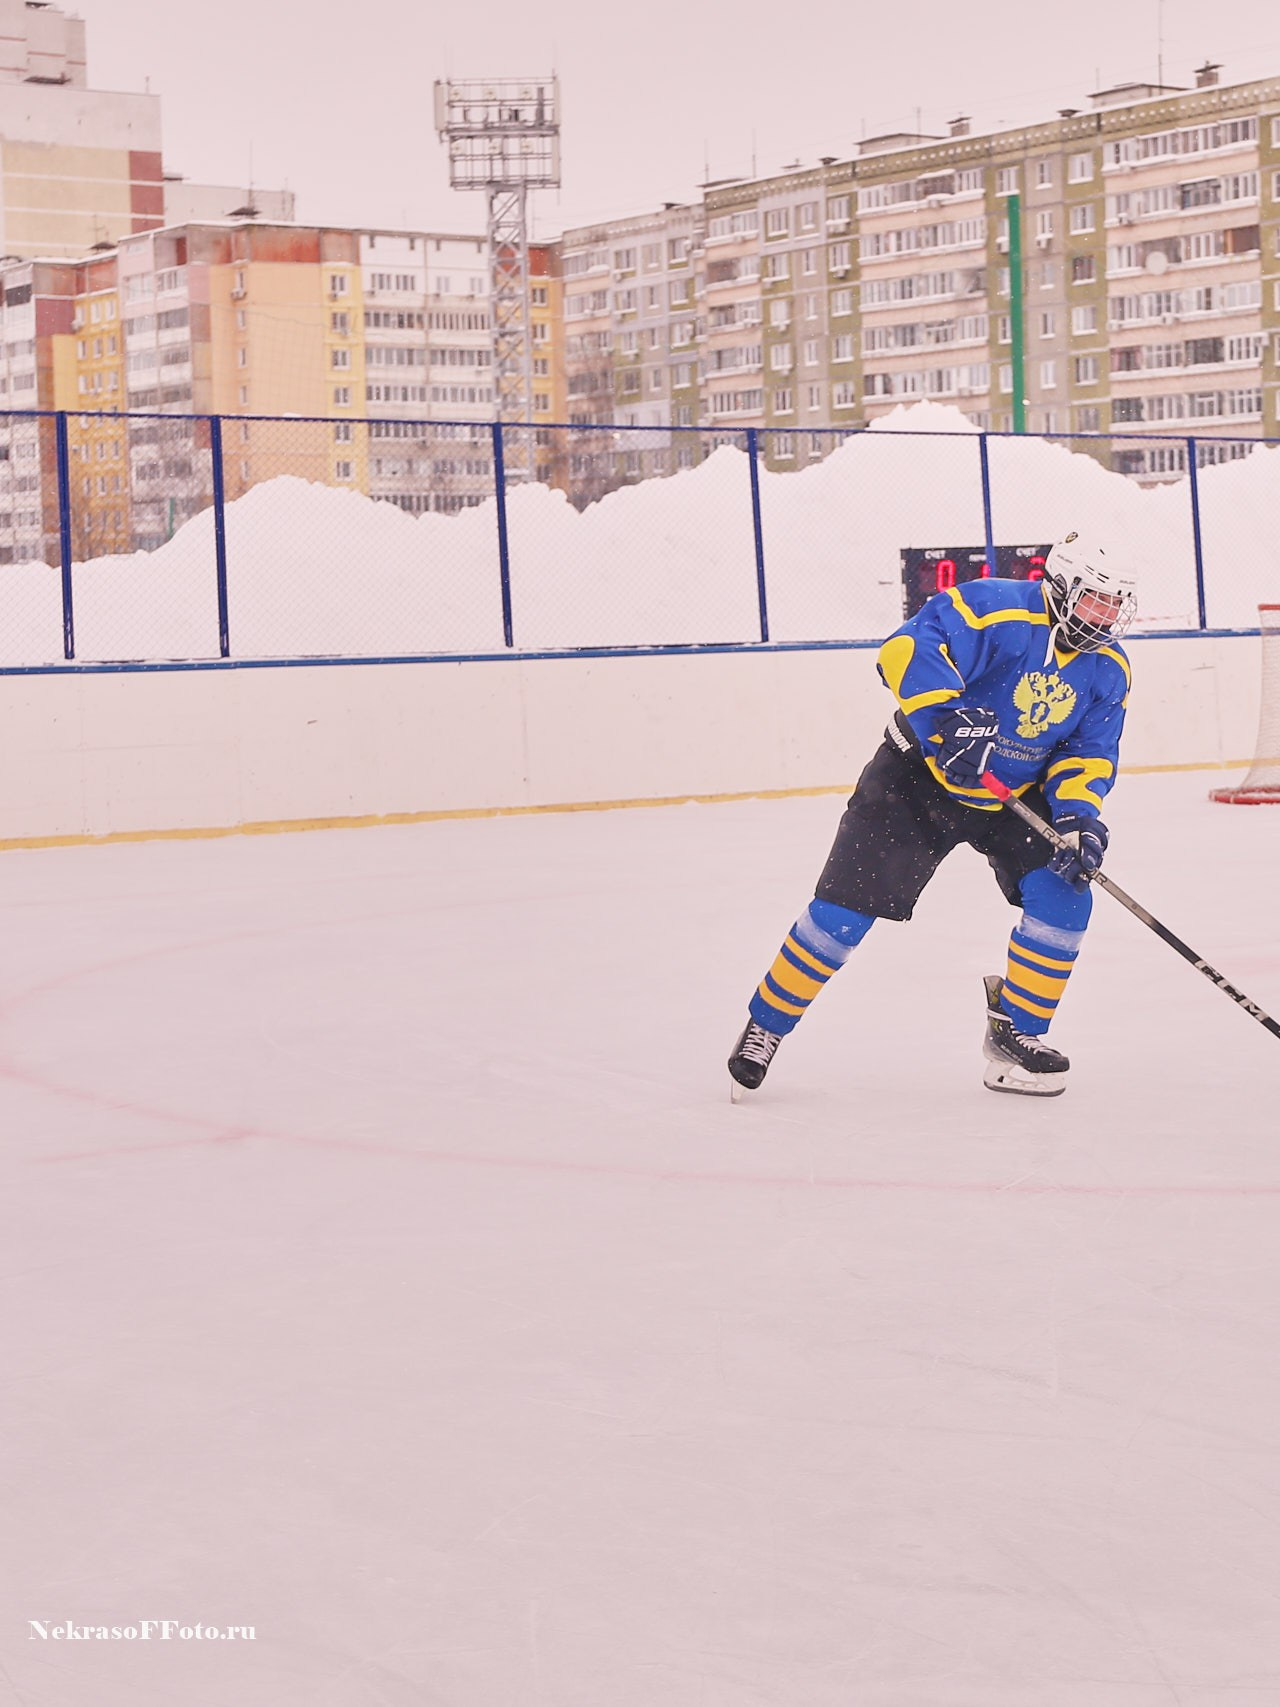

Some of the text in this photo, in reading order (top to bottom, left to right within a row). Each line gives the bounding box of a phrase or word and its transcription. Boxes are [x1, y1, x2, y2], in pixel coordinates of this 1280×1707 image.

[936, 559, 957, 593] 0
[954, 725, 999, 738] BAU
[1194, 959, 1268, 1022] CCM
